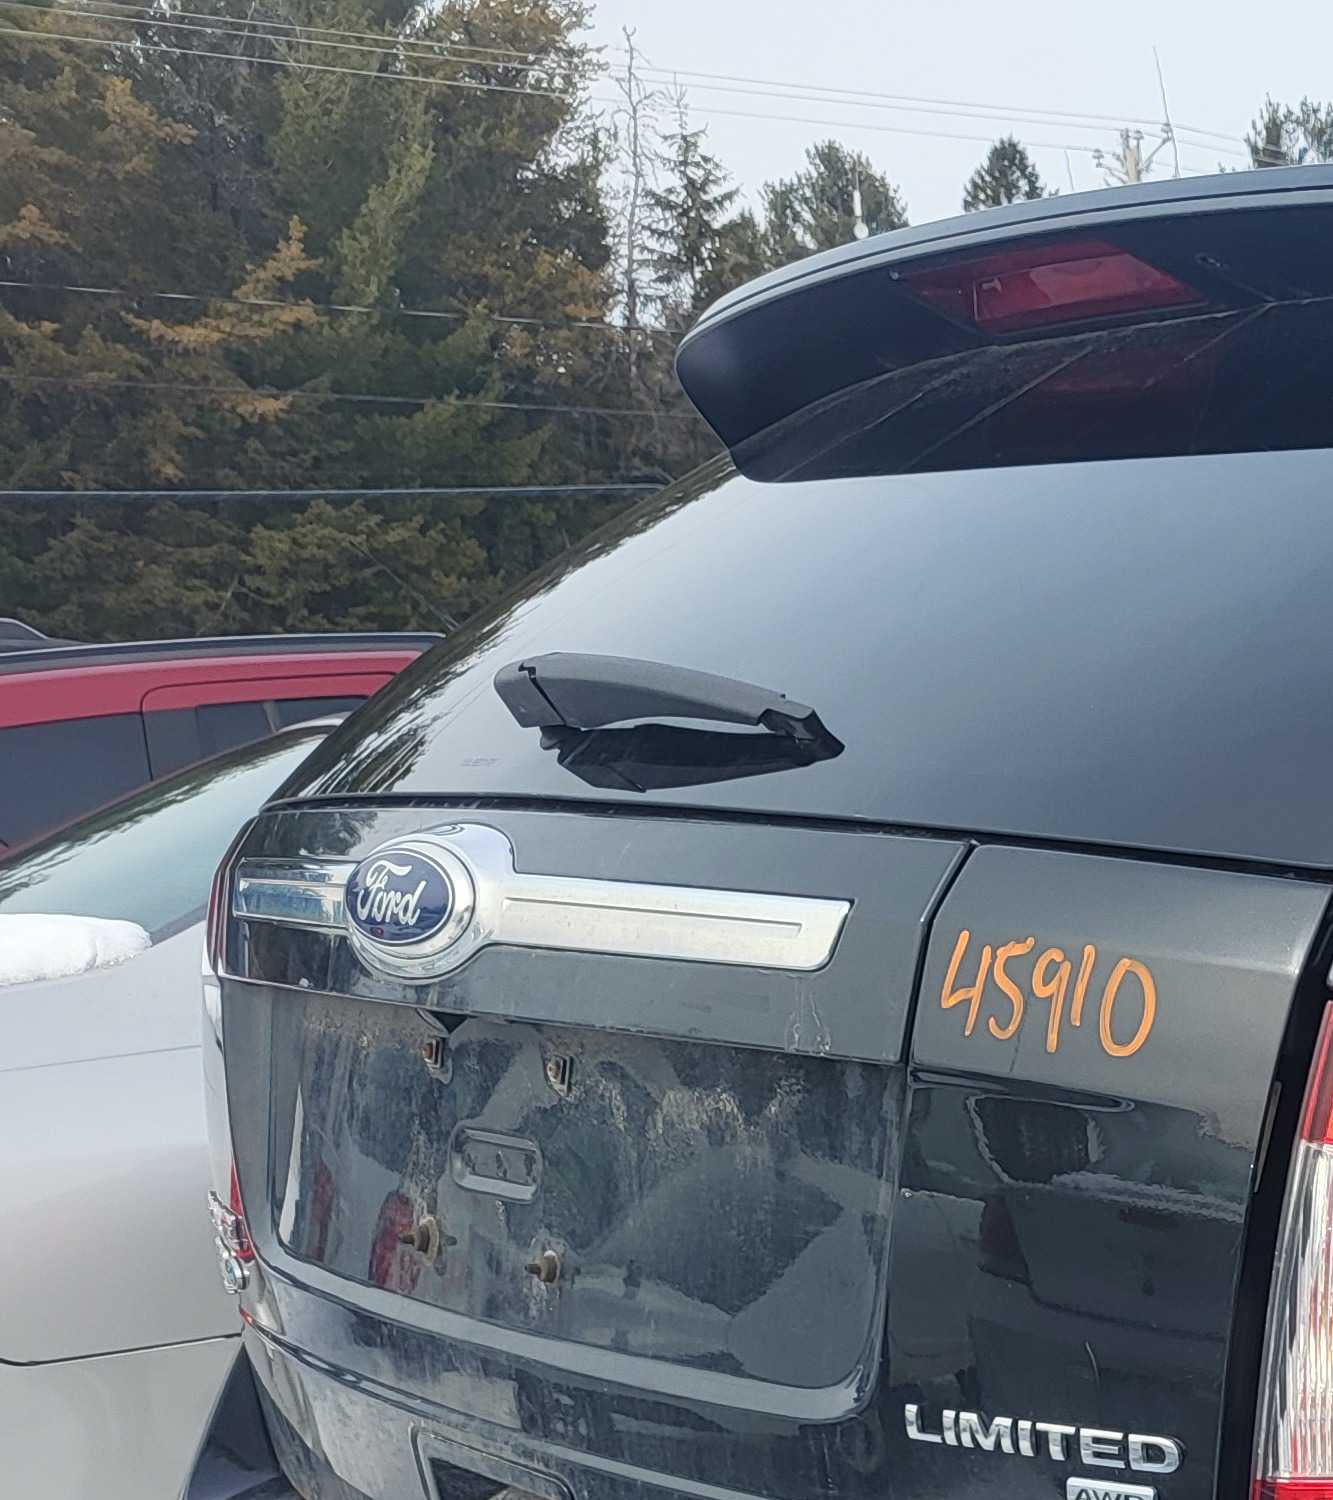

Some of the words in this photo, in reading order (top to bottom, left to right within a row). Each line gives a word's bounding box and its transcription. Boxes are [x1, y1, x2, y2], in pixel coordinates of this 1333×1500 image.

[354, 859, 427, 926] Ford
[940, 929, 1156, 1057] 45910
[904, 1403, 1184, 1474] LIMITED
